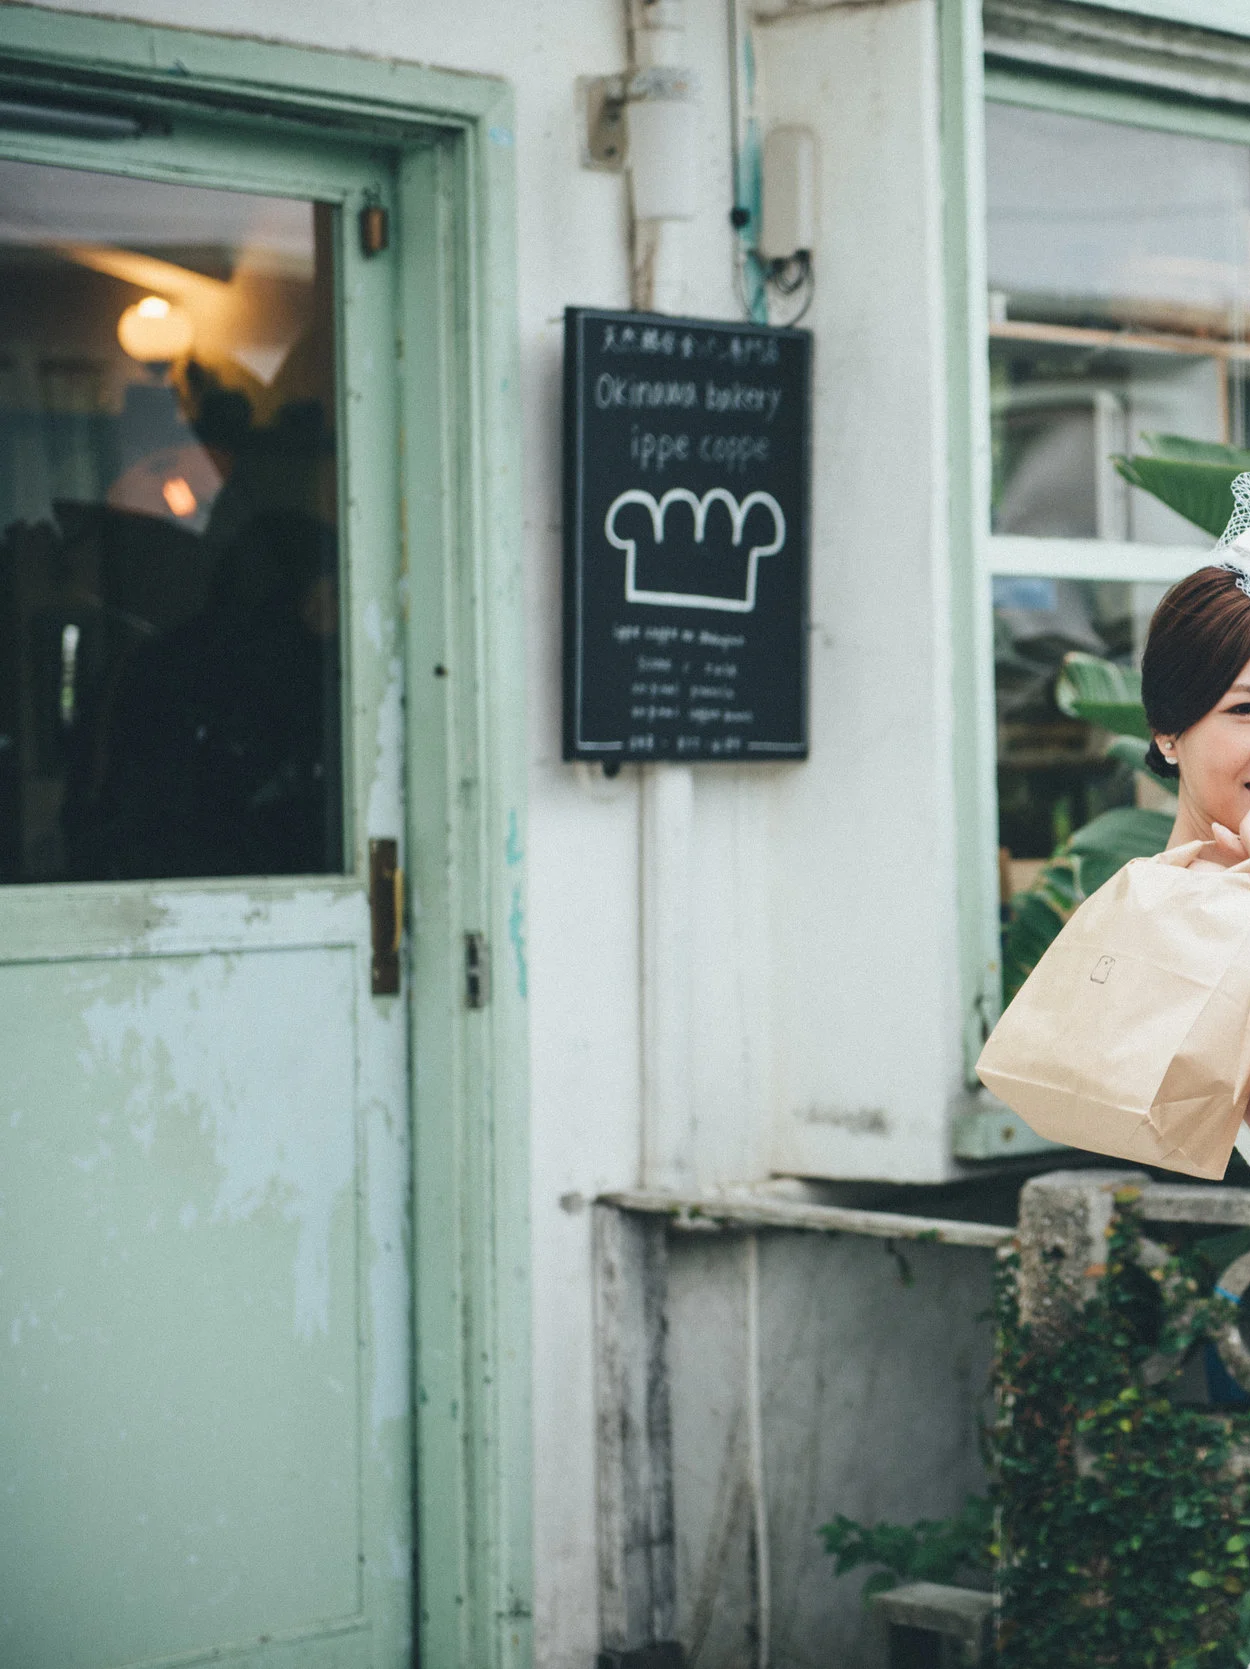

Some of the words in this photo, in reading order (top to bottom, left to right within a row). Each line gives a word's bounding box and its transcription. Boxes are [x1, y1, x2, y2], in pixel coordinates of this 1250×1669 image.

[596, 372, 698, 410] Okinawa
[704, 379, 781, 424] bakery
[630, 423, 690, 472] ippe
[699, 434, 770, 475] coppe
